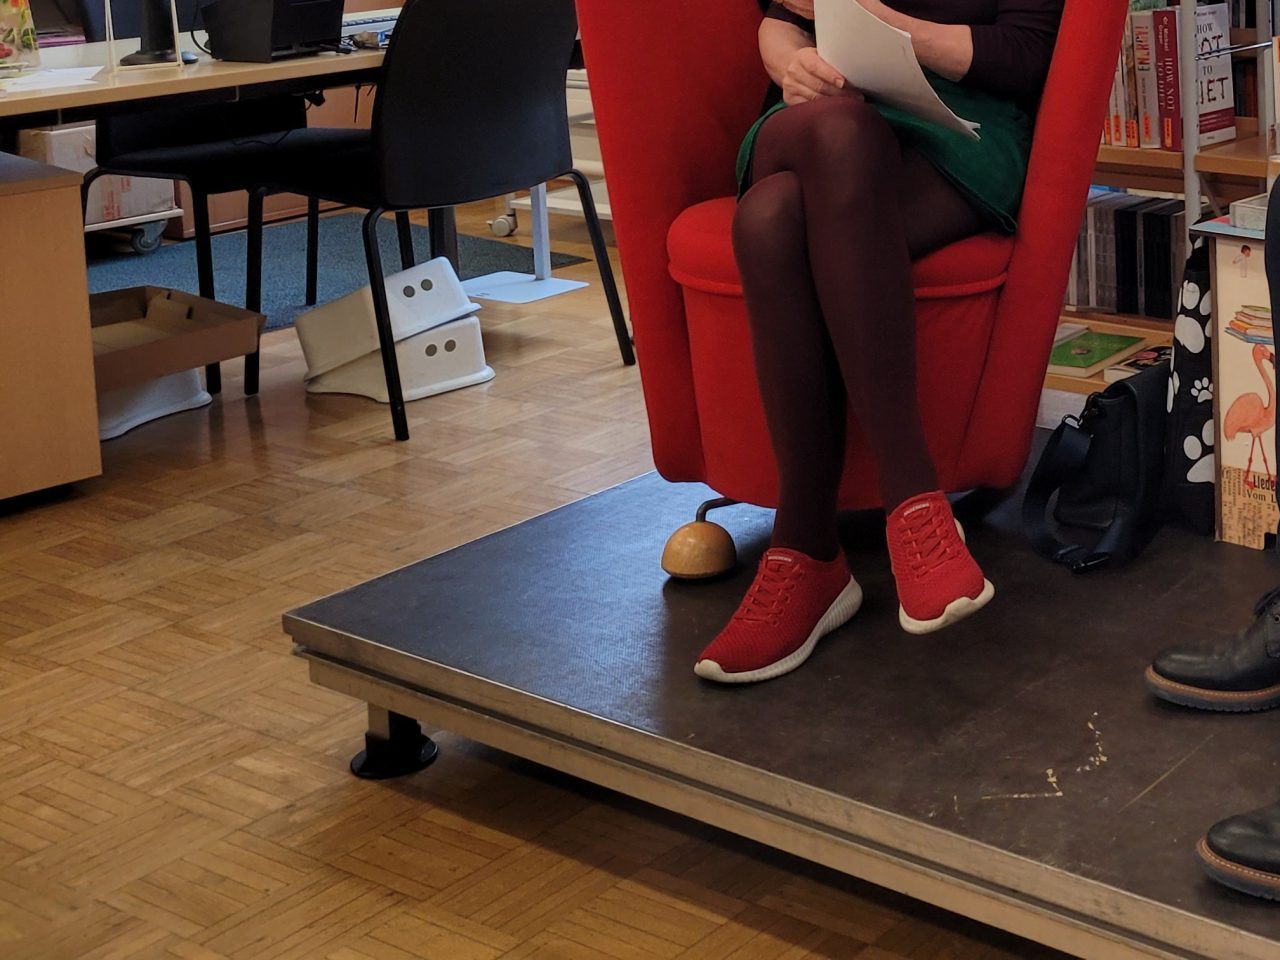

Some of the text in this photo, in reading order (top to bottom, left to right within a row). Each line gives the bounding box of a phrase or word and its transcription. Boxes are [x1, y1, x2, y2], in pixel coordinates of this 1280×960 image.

[1157, 62, 1166, 107] TO DIET
[1165, 57, 1175, 111] HOW NOT
[1202, 65, 1213, 76] TO
[1247, 490, 1267, 502] Vom
